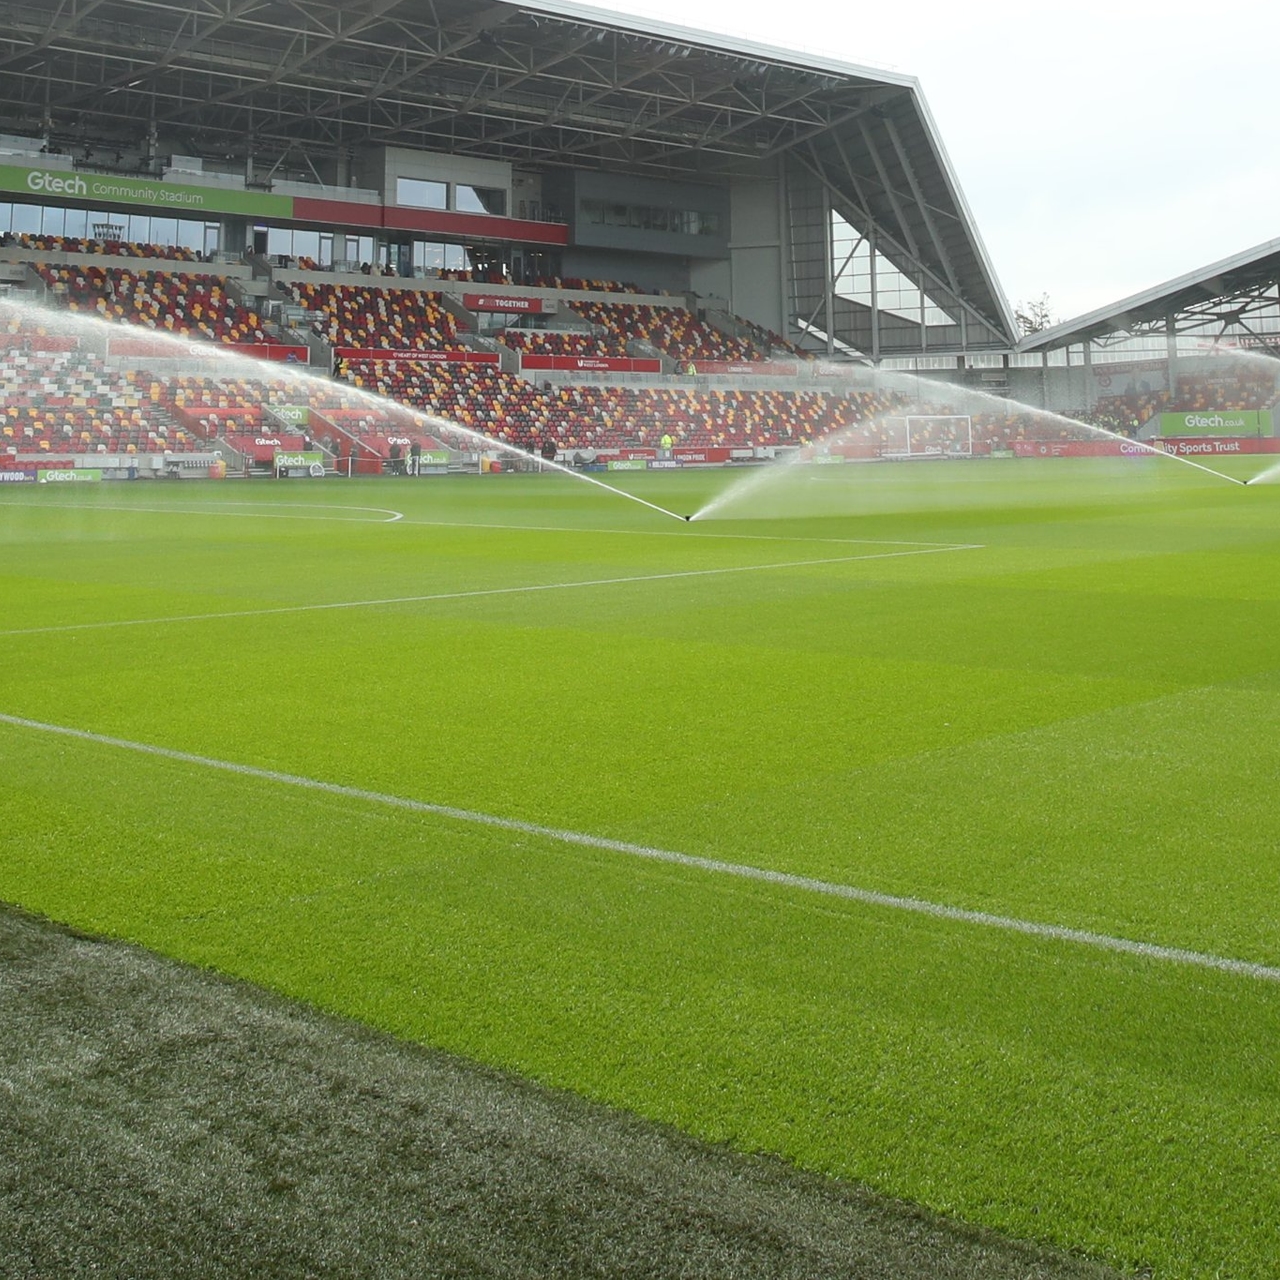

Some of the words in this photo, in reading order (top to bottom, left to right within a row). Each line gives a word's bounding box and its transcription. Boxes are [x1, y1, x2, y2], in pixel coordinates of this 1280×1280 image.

[26, 171, 87, 195] Gtech
[92, 182, 158, 202] Community
[159, 189, 204, 204] Stadium
[1185, 414, 1245, 428] Gtech.co.uk
[255, 438, 282, 446] Gtech
[1179, 443, 1212, 455] Sports
[1214, 441, 1240, 452] Trust
